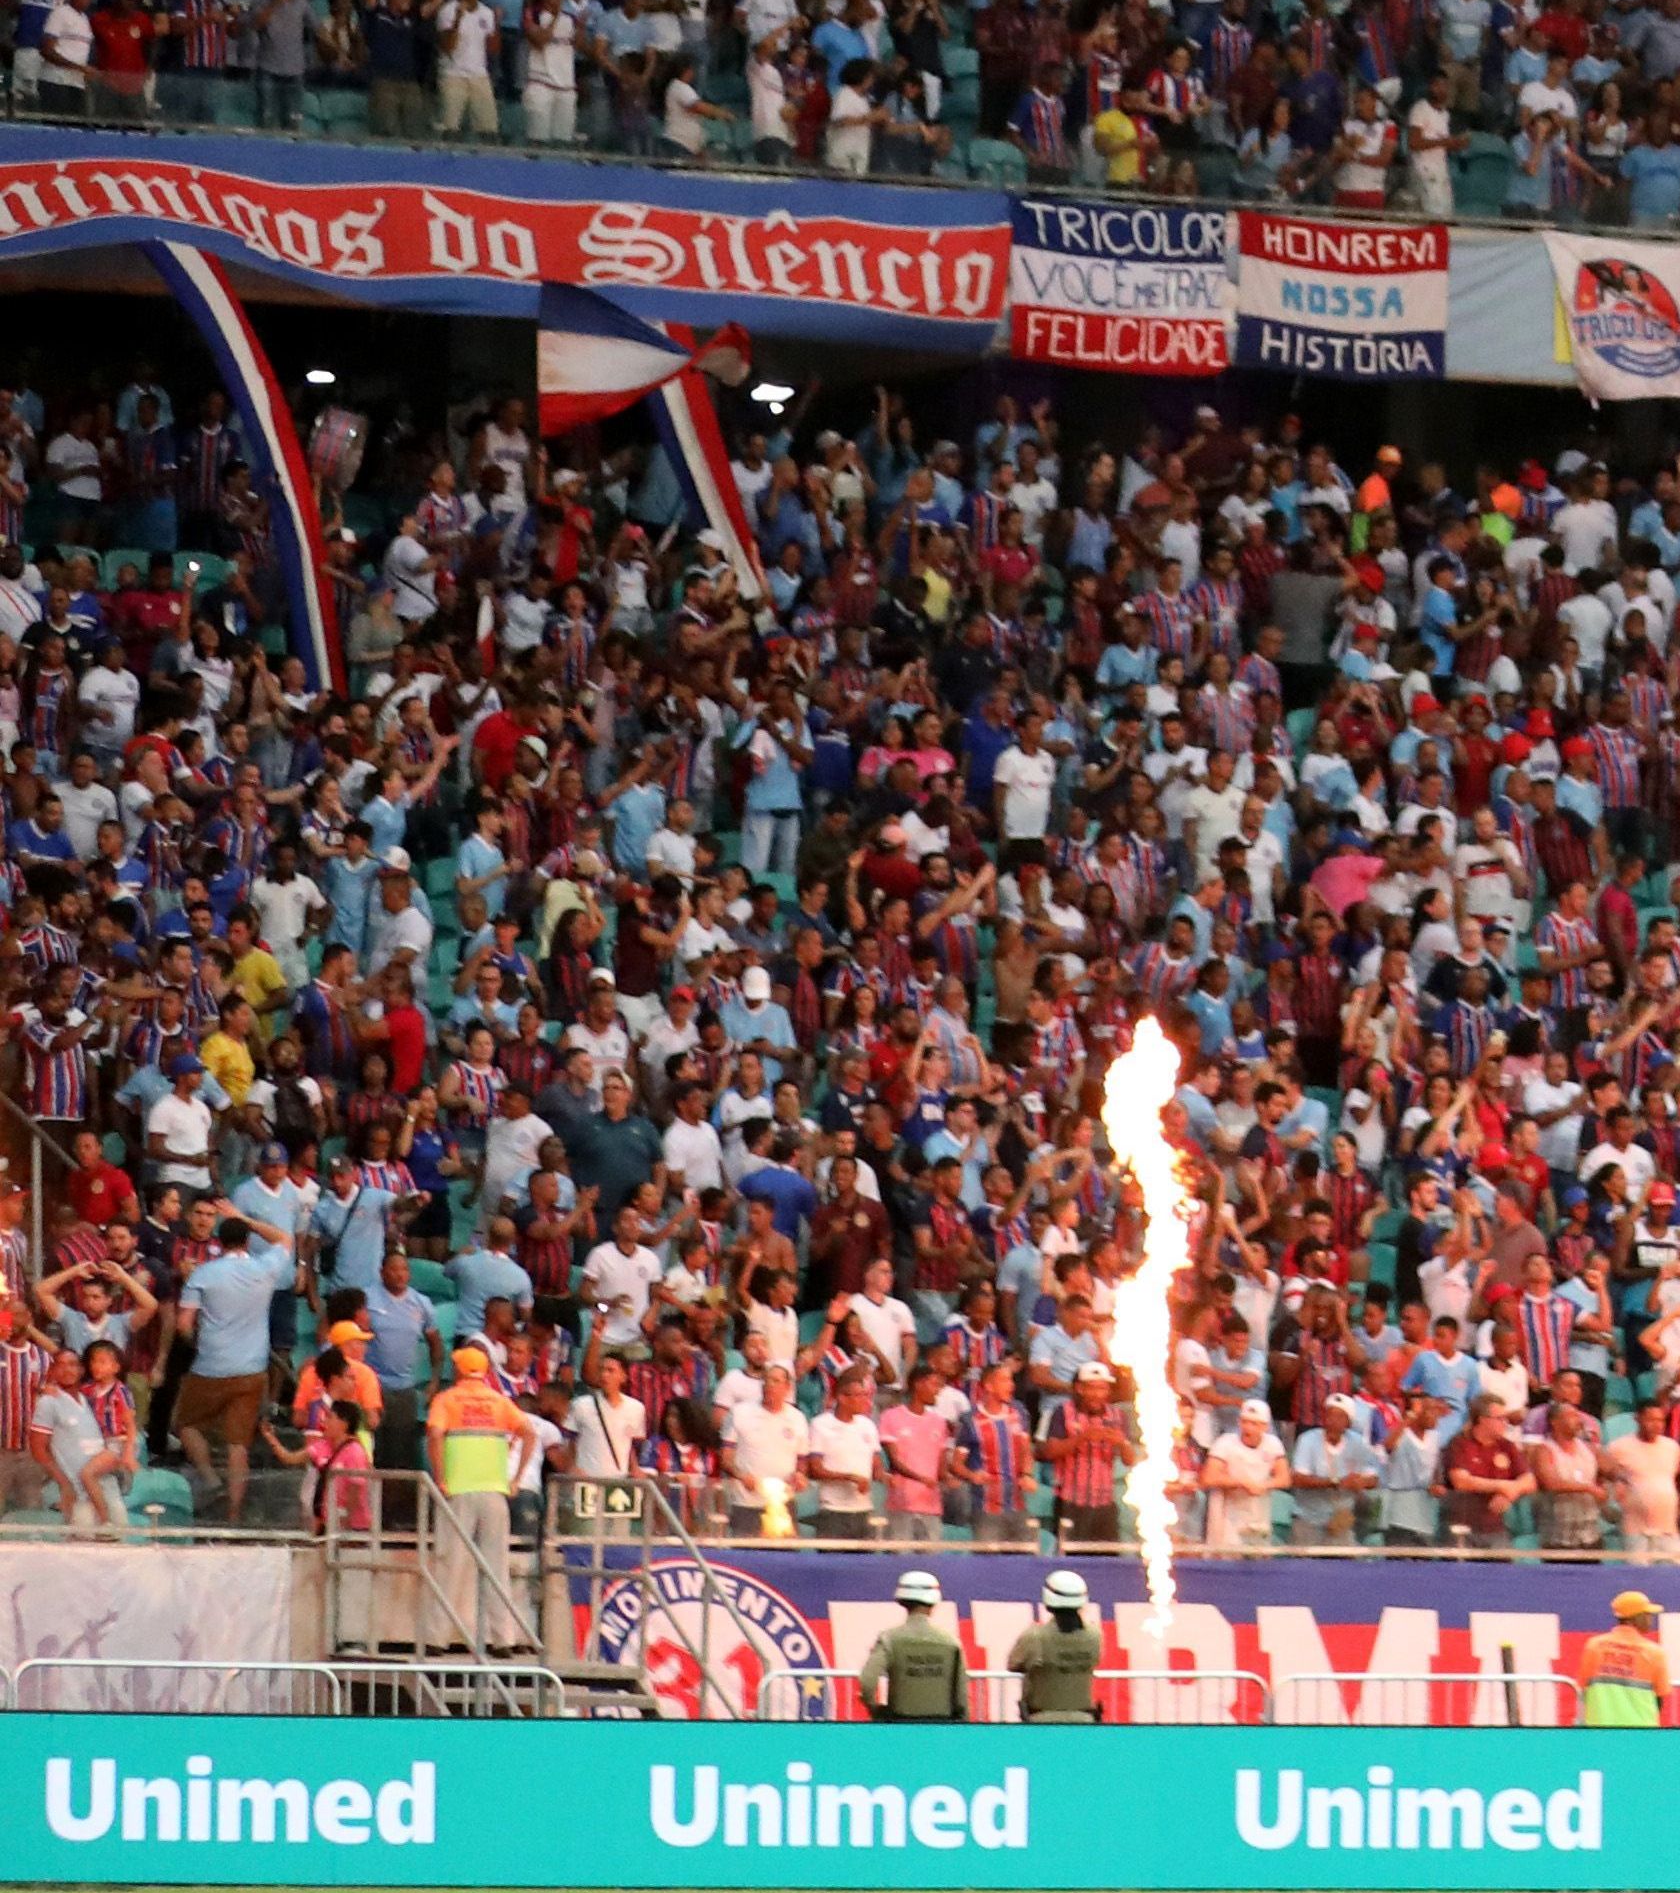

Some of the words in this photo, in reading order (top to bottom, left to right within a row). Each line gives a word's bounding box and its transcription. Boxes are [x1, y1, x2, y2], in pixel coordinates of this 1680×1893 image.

[425, 189, 539, 280] do
[577, 202, 998, 318] Silêncio
[1030, 201, 1227, 257] TRICOLOR
[1260, 227, 1439, 270] HONREM
[1281, 278, 1406, 321] NOSSA
[1024, 313, 1228, 367] FELICIDADE
[1260, 321, 1433, 377] HISTÓRIA
[47, 1757, 436, 1845] Unimed
[650, 1762, 1029, 1849] Unimed
[1236, 1766, 1604, 1851] Unimed
